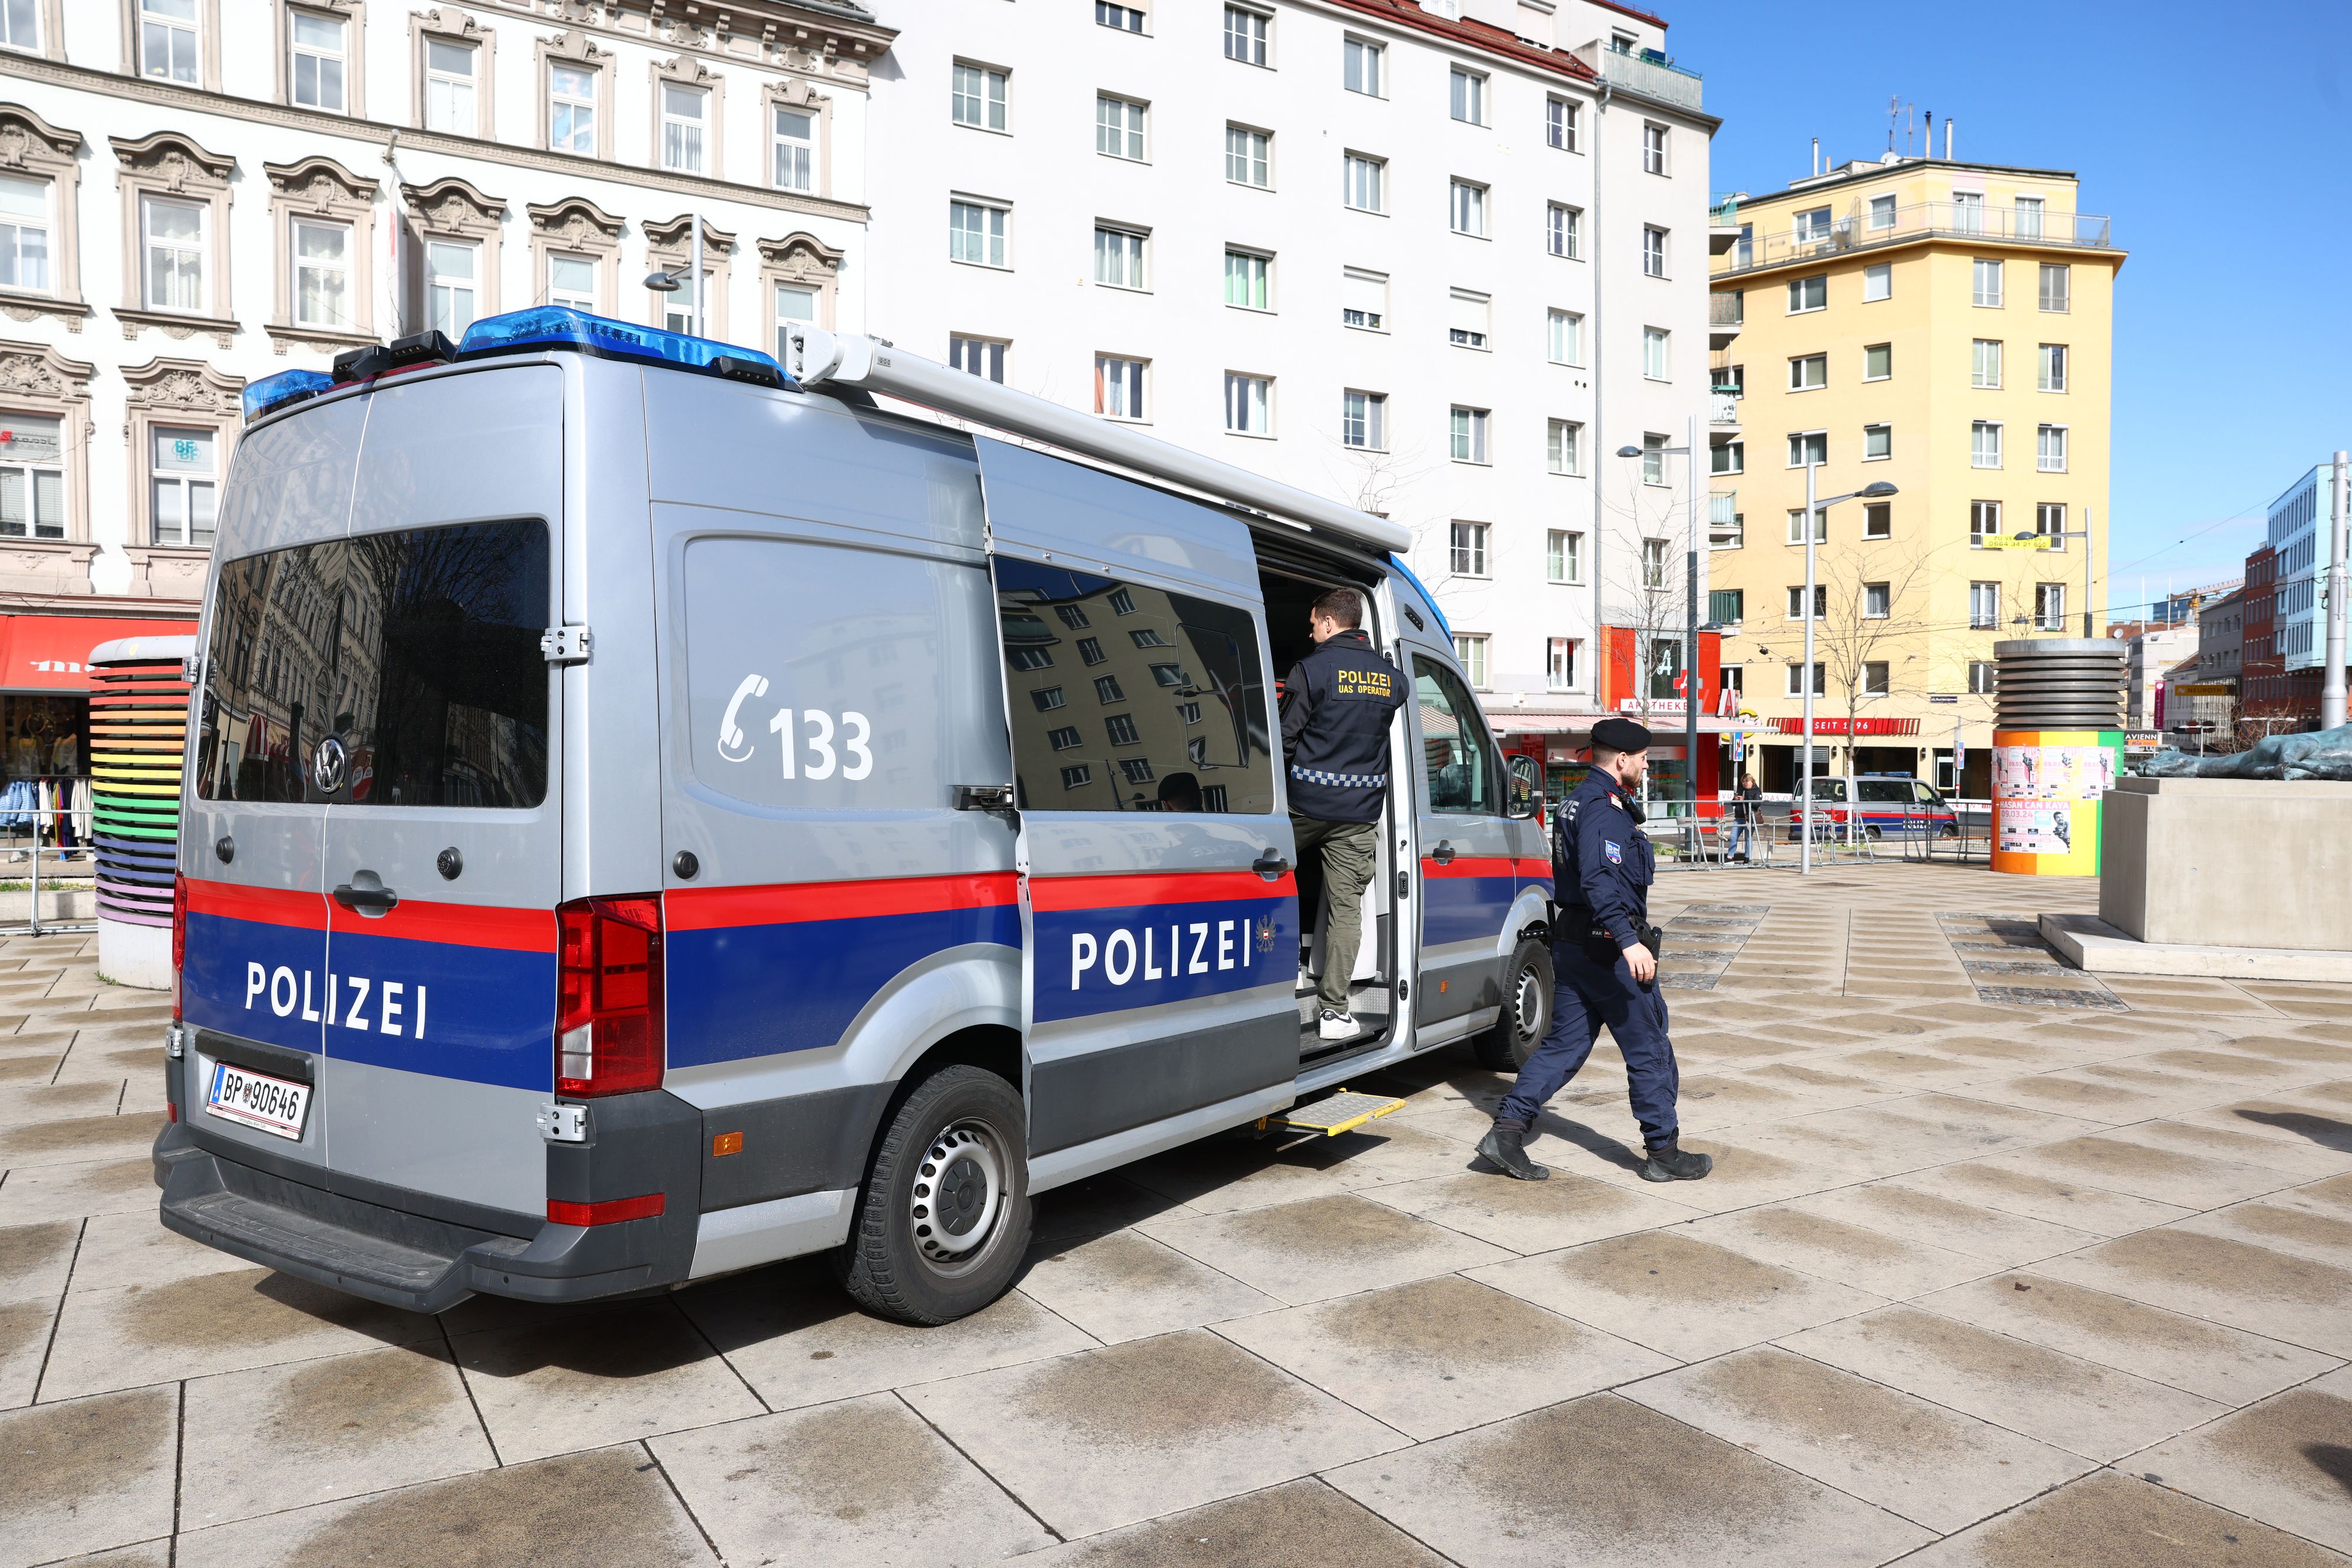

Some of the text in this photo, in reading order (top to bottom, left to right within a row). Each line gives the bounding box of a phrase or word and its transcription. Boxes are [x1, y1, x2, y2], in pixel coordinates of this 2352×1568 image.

[1338, 670, 1391, 687] POLIZEI
[1338, 685, 1391, 697] UAS OPERATOR
[770, 708, 873, 781] 133
[1071, 918, 1250, 991] POLIZEI
[245, 961, 426, 1039] POLIZEI
[223, 1073, 299, 1121] BP 90646
